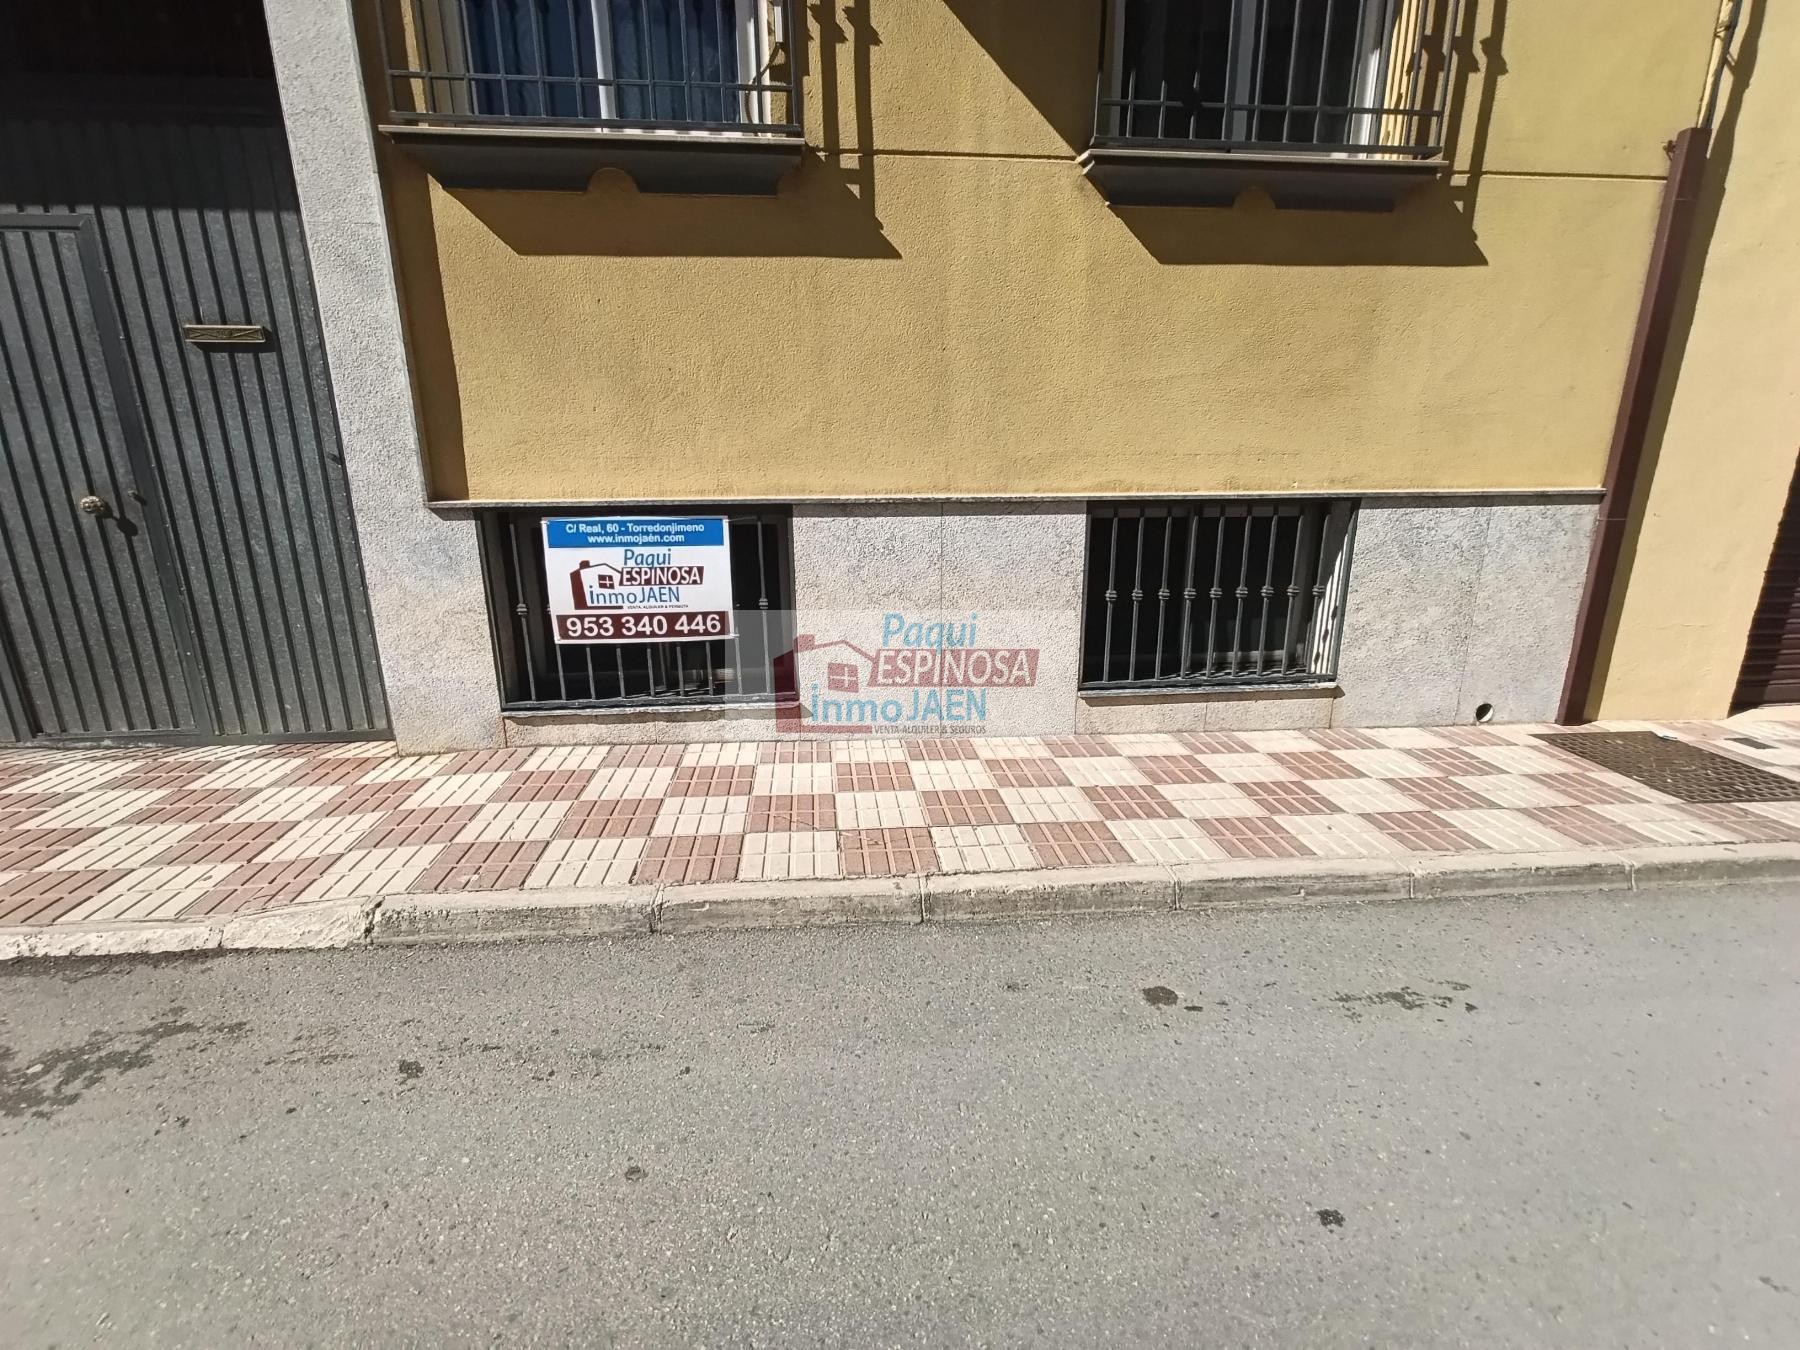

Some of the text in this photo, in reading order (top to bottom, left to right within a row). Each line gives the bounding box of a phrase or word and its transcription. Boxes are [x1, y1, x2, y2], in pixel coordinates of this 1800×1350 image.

[579, 522, 605, 534] Real,
[606, 523, 619, 533] 60
[627, 523, 705, 534] Torredonjimeno
[623, 548, 672, 567] Paqui
[622, 566, 701, 585] ESPINOSA
[589, 585, 680, 604] inmoJAEN
[566, 614, 721, 637] 953 340 446
